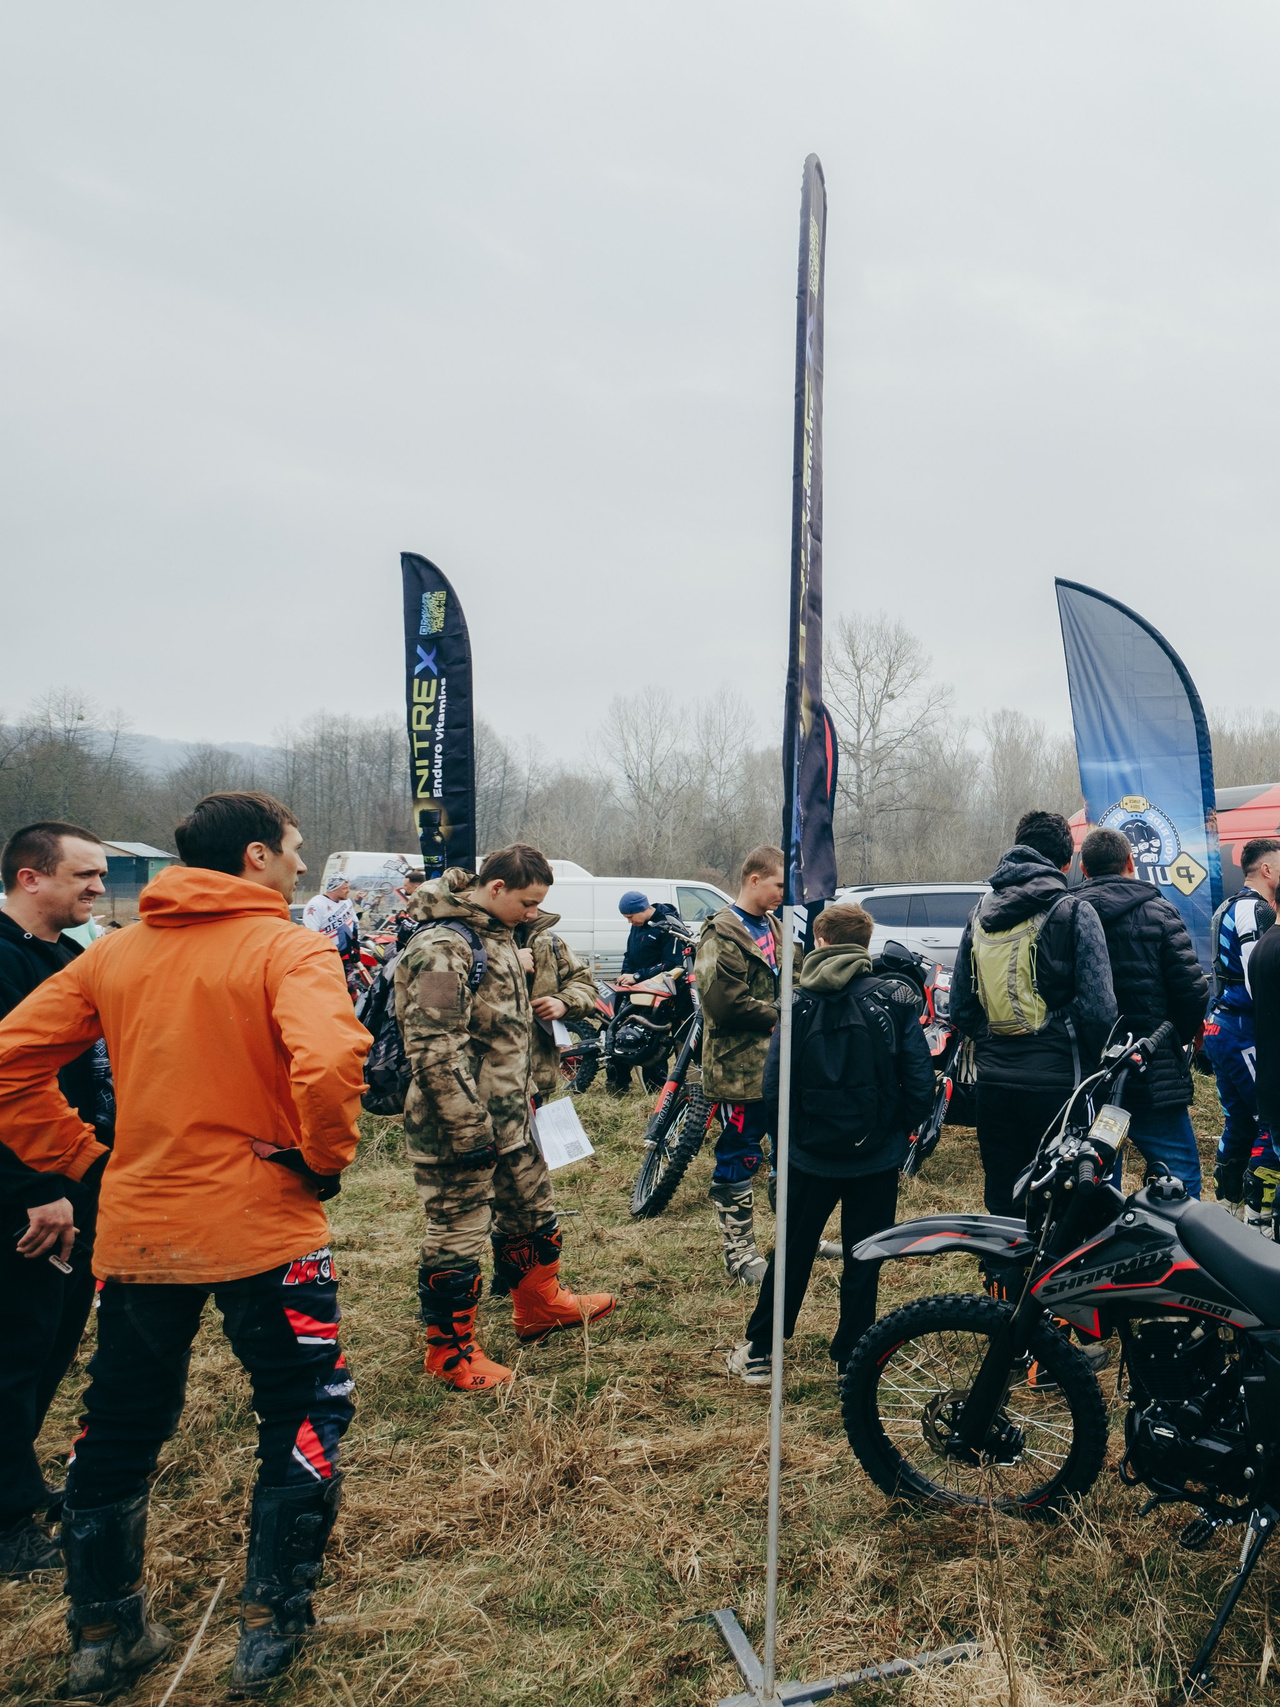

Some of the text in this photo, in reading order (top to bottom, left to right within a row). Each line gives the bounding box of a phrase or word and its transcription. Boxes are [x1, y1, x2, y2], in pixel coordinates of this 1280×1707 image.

[411, 644, 438, 799] NITREX
[433, 677, 447, 798] Enduro vitamins
[660, 1090, 675, 1125] KENDA
[1040, 1247, 1176, 1298] SHARMAX
[1178, 1297, 1233, 1319] NIBBI
[470, 1376, 486, 1386] X6
